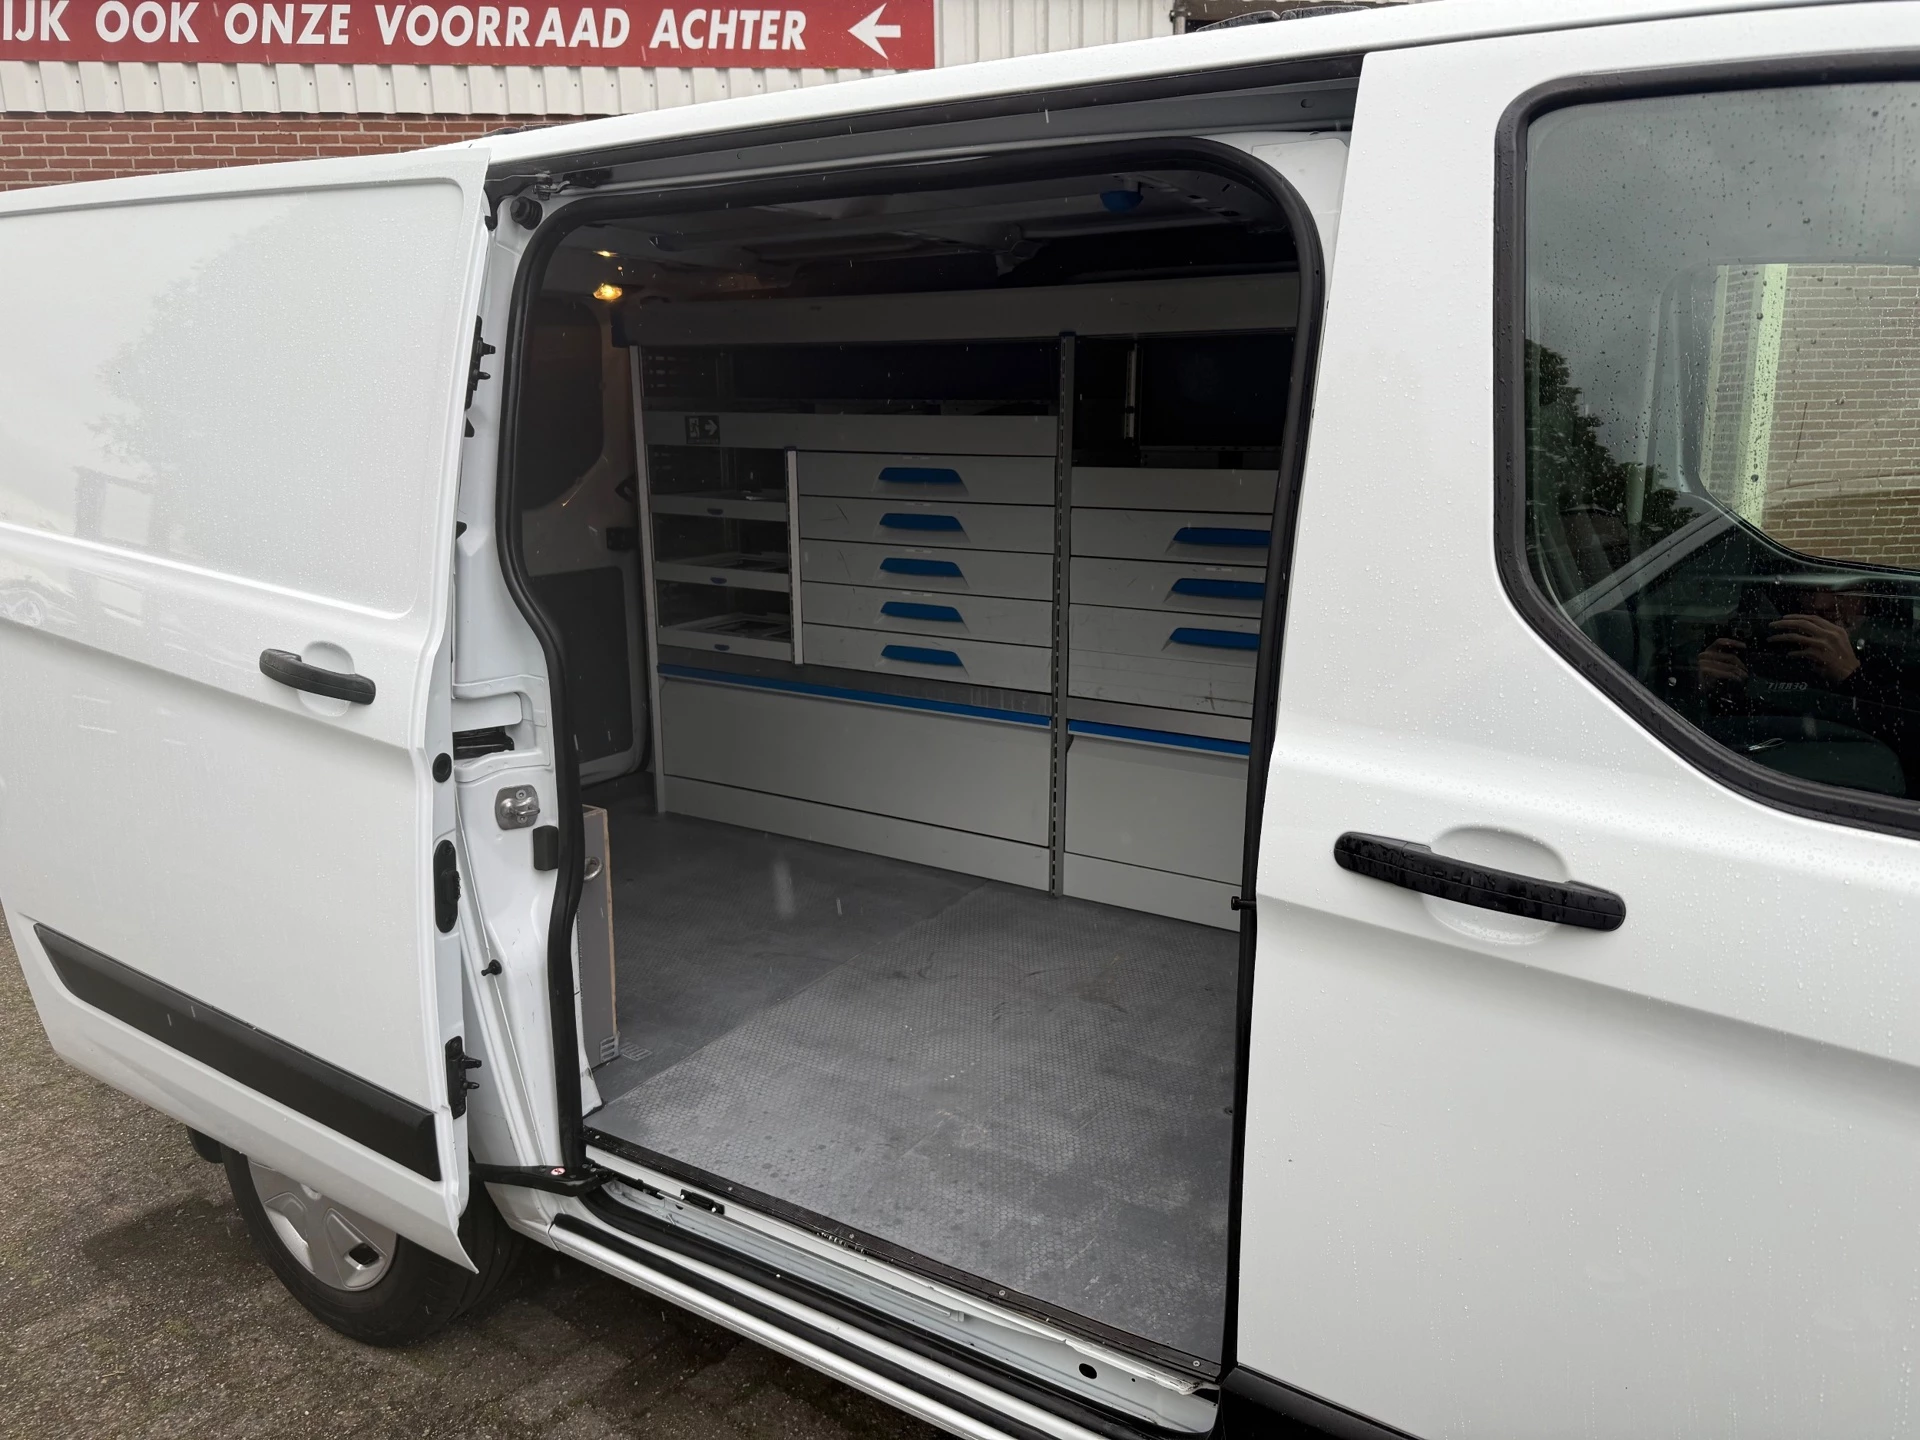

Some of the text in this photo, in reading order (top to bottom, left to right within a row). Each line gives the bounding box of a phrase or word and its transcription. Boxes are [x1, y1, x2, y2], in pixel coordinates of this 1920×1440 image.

[95, 0, 199, 43] OOK
[224, 2, 350, 45] ONZE
[375, 5, 630, 48] VOORRAAD
[650, 8, 807, 51] ACHTER
